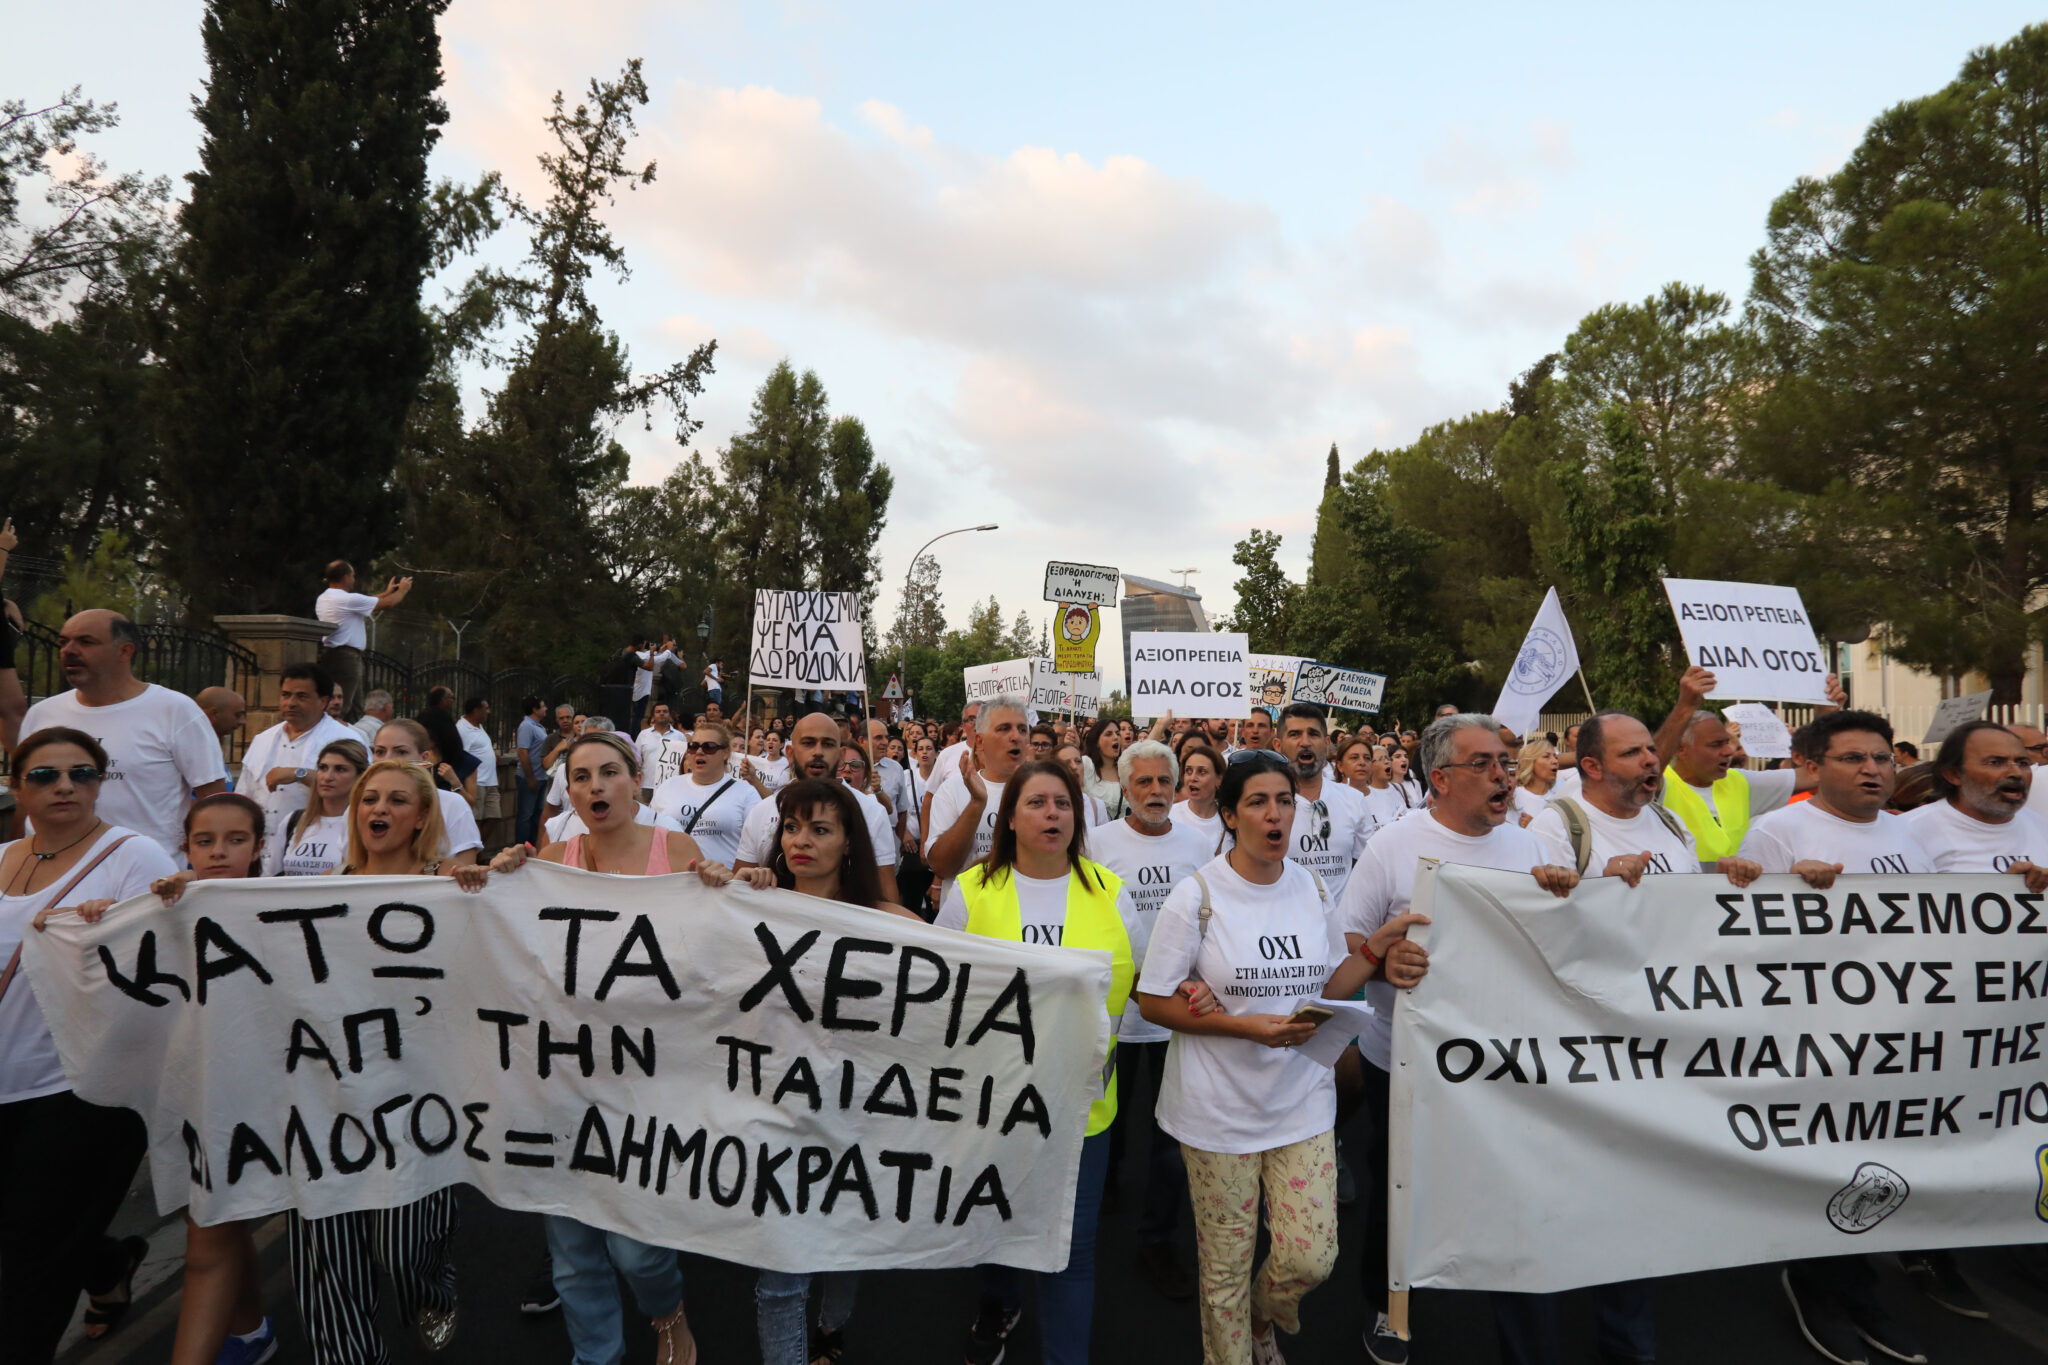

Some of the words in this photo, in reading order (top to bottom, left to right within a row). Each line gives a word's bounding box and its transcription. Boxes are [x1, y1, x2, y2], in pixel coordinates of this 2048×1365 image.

[1050, 566, 1117, 582] ΕΞΟΡΘΟΛΟΓΙΣΜΟΣ
[1054, 587, 1105, 602] ΔΙΑΛΥΣΗ;
[755, 590, 861, 623] ΑΥΤΑΡΧΙΣΜΟΣ
[1681, 603, 1806, 625] ΑΞΙΟΠΡΕΠΕΙΑ
[757, 620, 839, 652] ΨΕΜΑ
[1135, 648, 1242, 662] ΑΞΙΟΠΡΕΠΕΙΑ
[750, 648, 866, 684] ΔΩΡΟΔΟΚΙΑ
[1340, 683, 1372, 696] ΠΑΙΔΕΙΑ
[1341, 672, 1377, 686] ΕΛΕΥΘΕΡΗ
[1341, 695, 1380, 711] ΔΙΚΤΑΤΟΡΙΑ
[295, 843, 328, 857] ΟΧΙ
[1646, 853, 1673, 874] ΧΙ
[1870, 853, 1910, 874] ΟΧΙ
[1138, 866, 1171, 886] ΟΧΙ
[1716, 891, 2048, 936] ΣΕΒΑΣΜΟΣ
[1258, 935, 1303, 960] ΟΧΙ
[1235, 967, 1258, 980] ΣΤΗ
[1260, 965, 1305, 979] ΔΙΑΛΥΣΗ
[1307, 964, 1327, 977] ΤΟΥ
[97, 902, 444, 1006] ΚΑΤΩ
[538, 907, 682, 1001] ΤΑ
[739, 921, 1036, 1064] ΧΕΡΙΑ
[1224, 984, 1282, 998] ΔΗΜΟΣΙΟΥ
[1645, 963, 1743, 1012] ΚΑΙ
[1760, 960, 1957, 1006] ΣΤΟΥΣ
[1975, 959, 2048, 1003] ΕΚ
[1435, 1036, 1548, 1085] ΟΧΙ
[1559, 1034, 1669, 1084] ΣΤΗ
[1684, 1030, 1944, 1079] ΔΙΑΛΥΣΗ
[1962, 1020, 2046, 1071] ΤΗΣ
[477, 1008, 656, 1079] ΤΗΝ
[716, 1036, 1052, 1138] ΠΑΙΔΕΙΑ
[1727, 1094, 1965, 1152] ΟΕΛΜΕΚ
